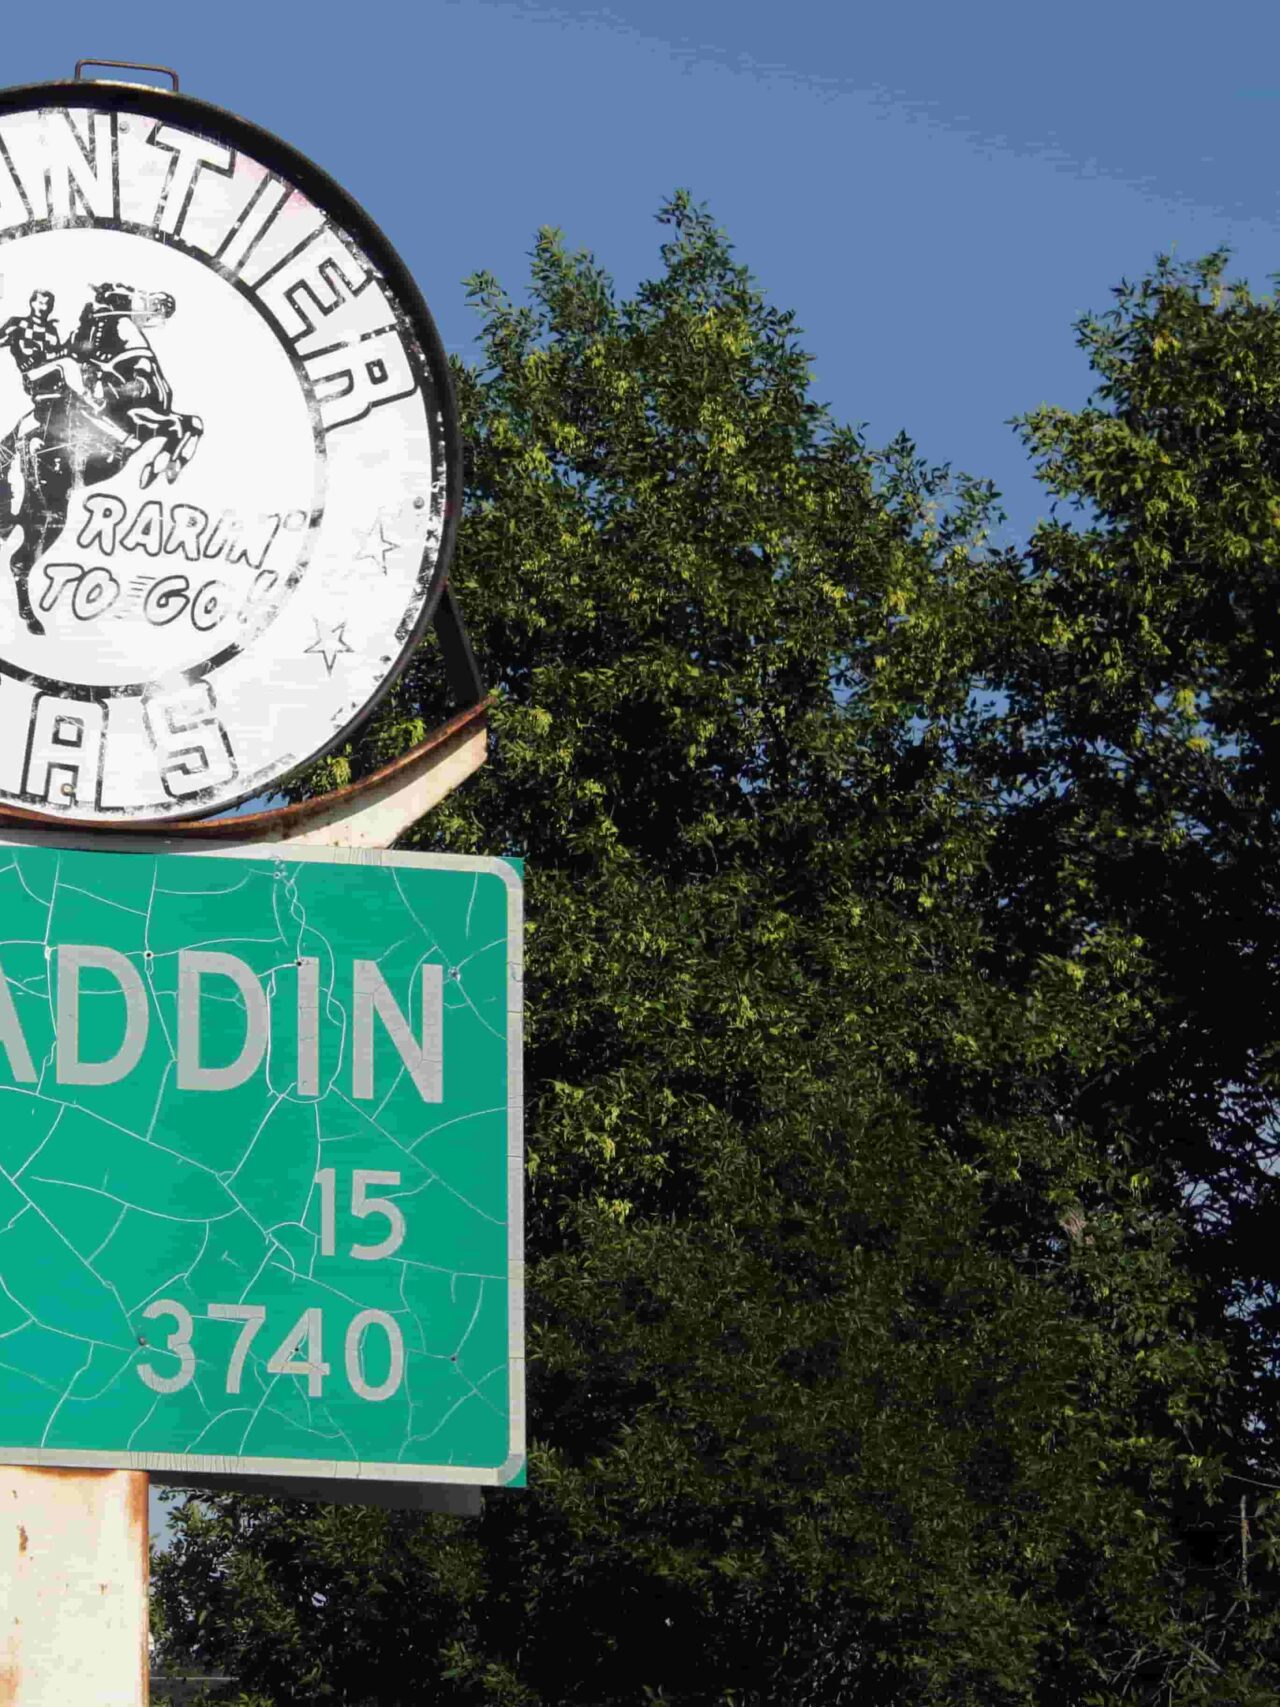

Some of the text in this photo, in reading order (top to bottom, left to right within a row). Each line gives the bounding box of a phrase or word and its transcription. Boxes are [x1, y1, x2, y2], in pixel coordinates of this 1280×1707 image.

[39, 562, 121, 621] TO
[318, 1167, 404, 1261] 15
[134, 1299, 405, 1402] 3740
